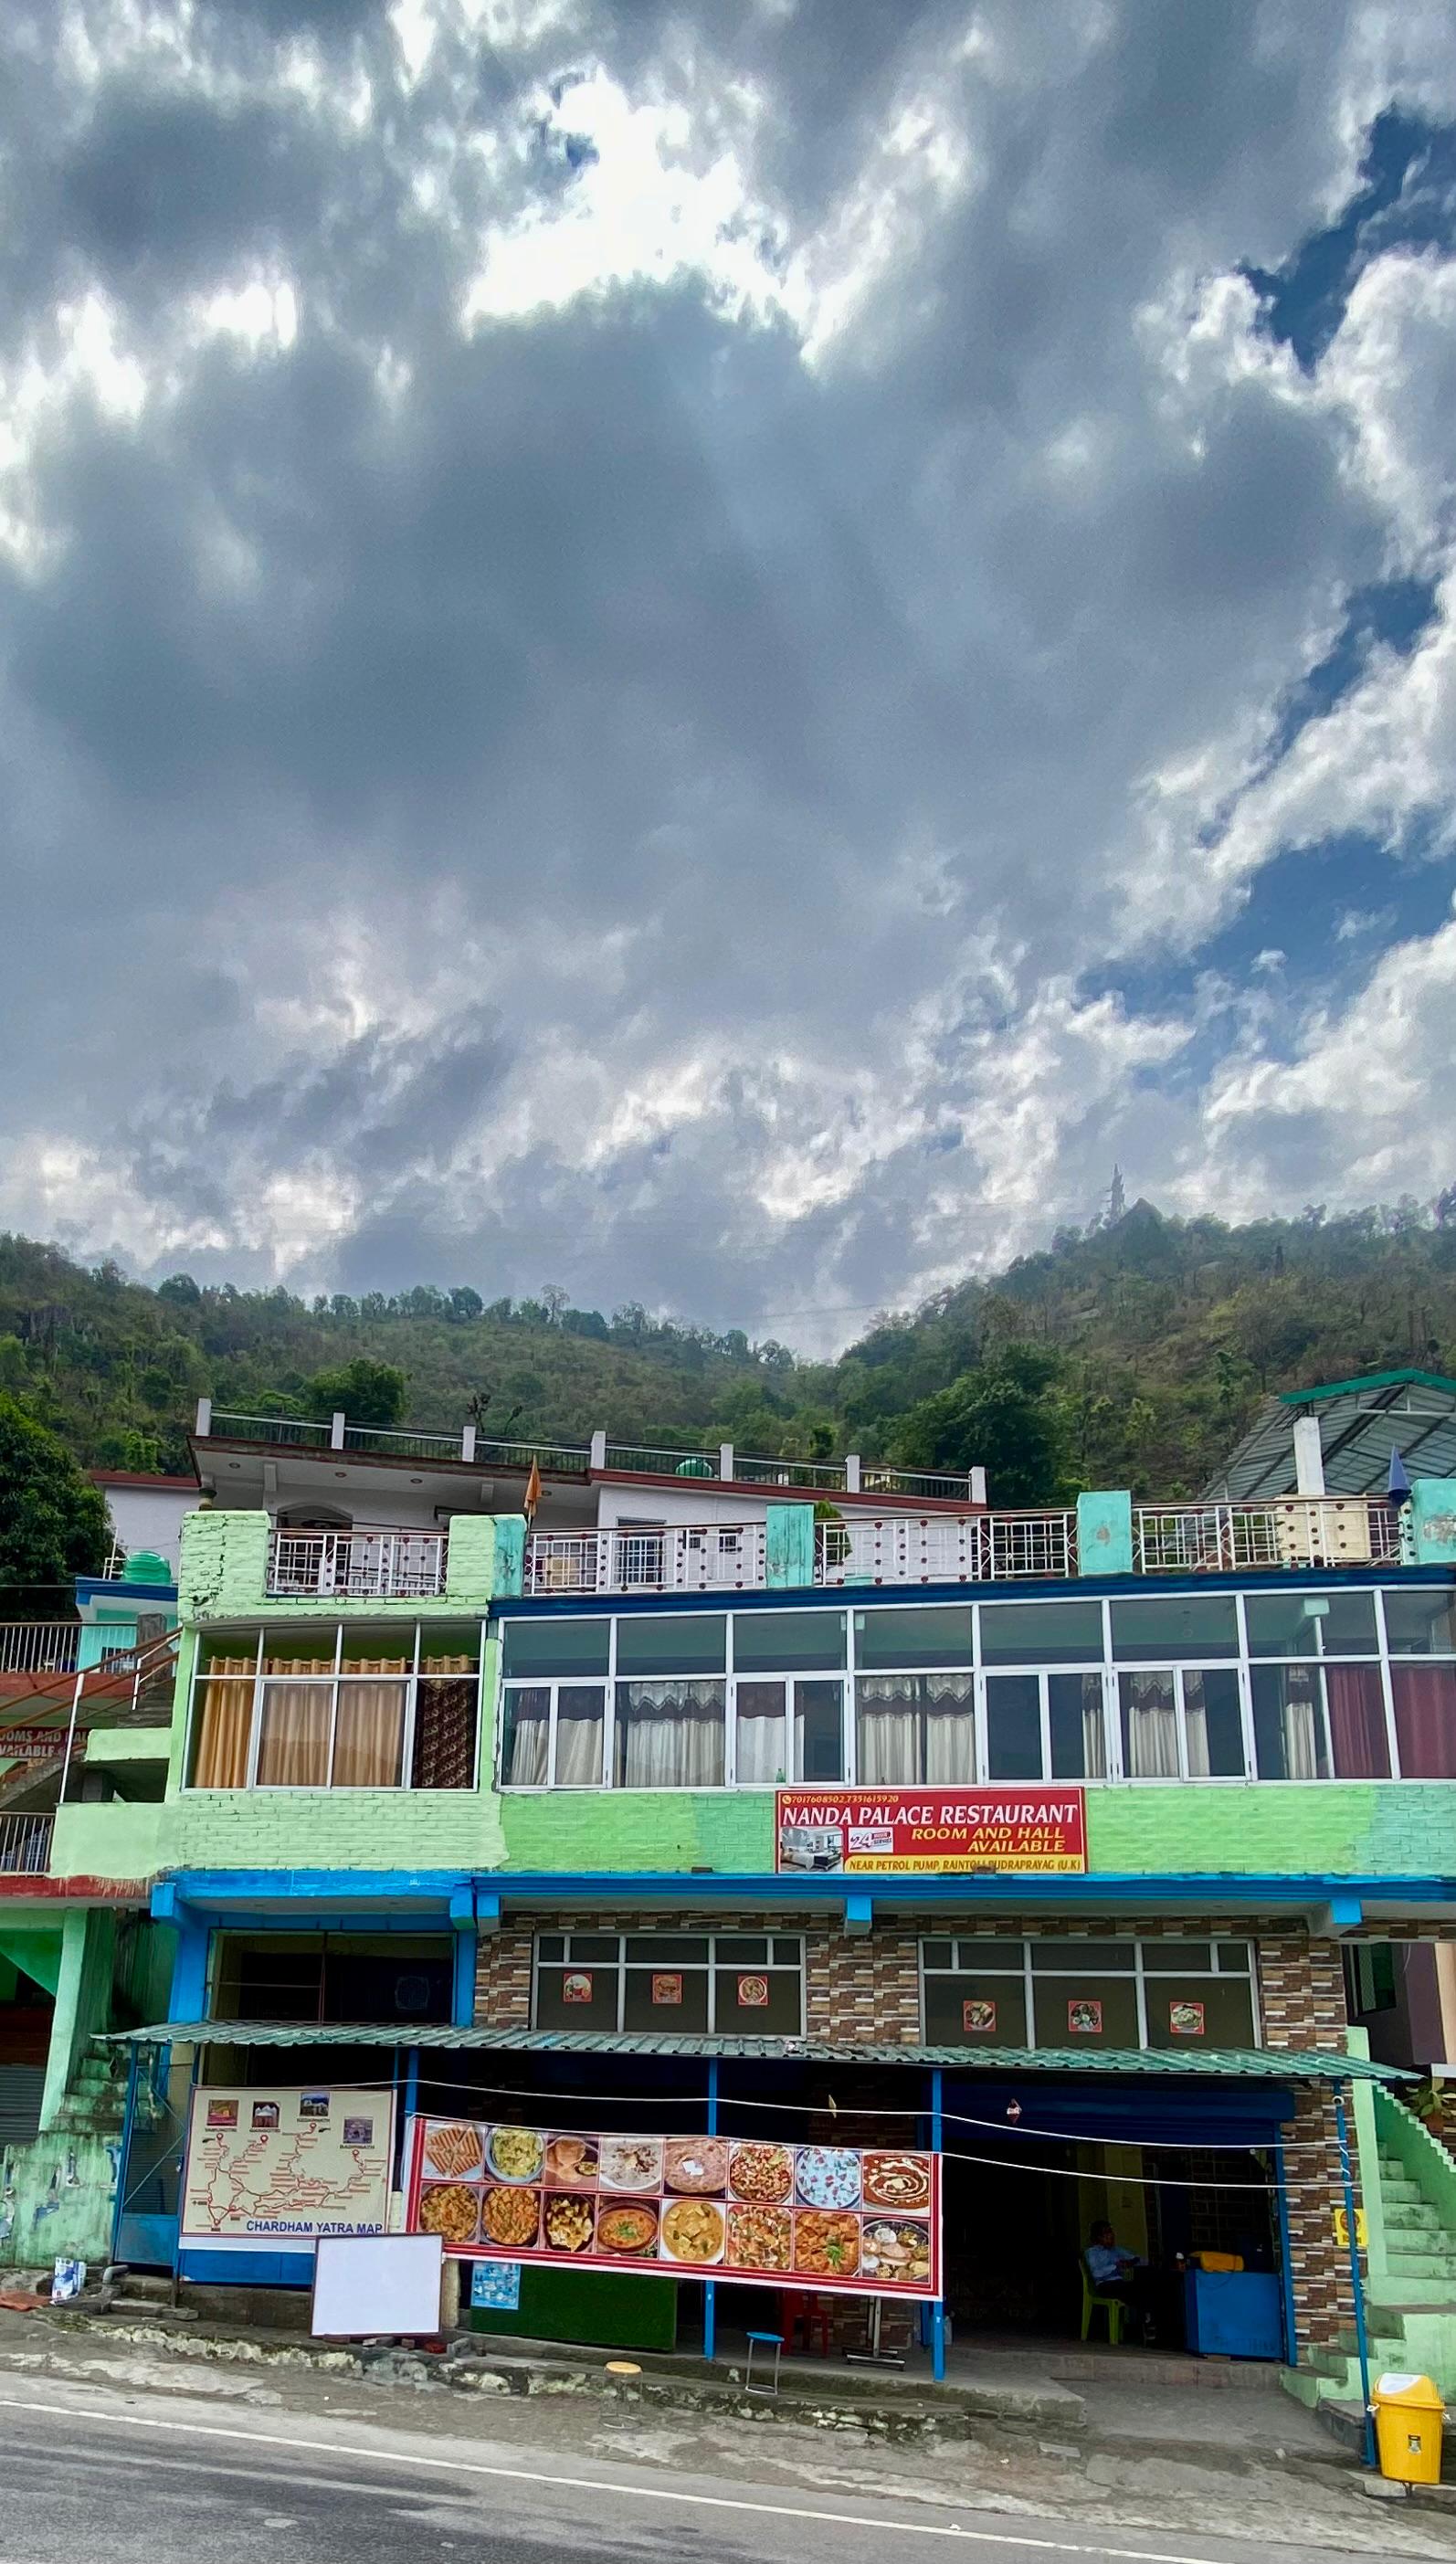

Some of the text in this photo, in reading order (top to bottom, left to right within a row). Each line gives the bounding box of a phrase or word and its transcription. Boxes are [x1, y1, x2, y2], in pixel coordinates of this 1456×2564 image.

[782, 1804, 1078, 1826] NANDA PALACE RESTAURANT
[912, 1827, 1065, 1840] ROOM AND HALL
[849, 1831, 874, 1850] 24
[967, 1840, 1066, 1852] AVAILABLE
[849, 1860, 874, 1871] NEAR
[876, 1860, 910, 1871] PETROL
[246, 2220, 383, 2234] CHARDHAM YATRA MAP
